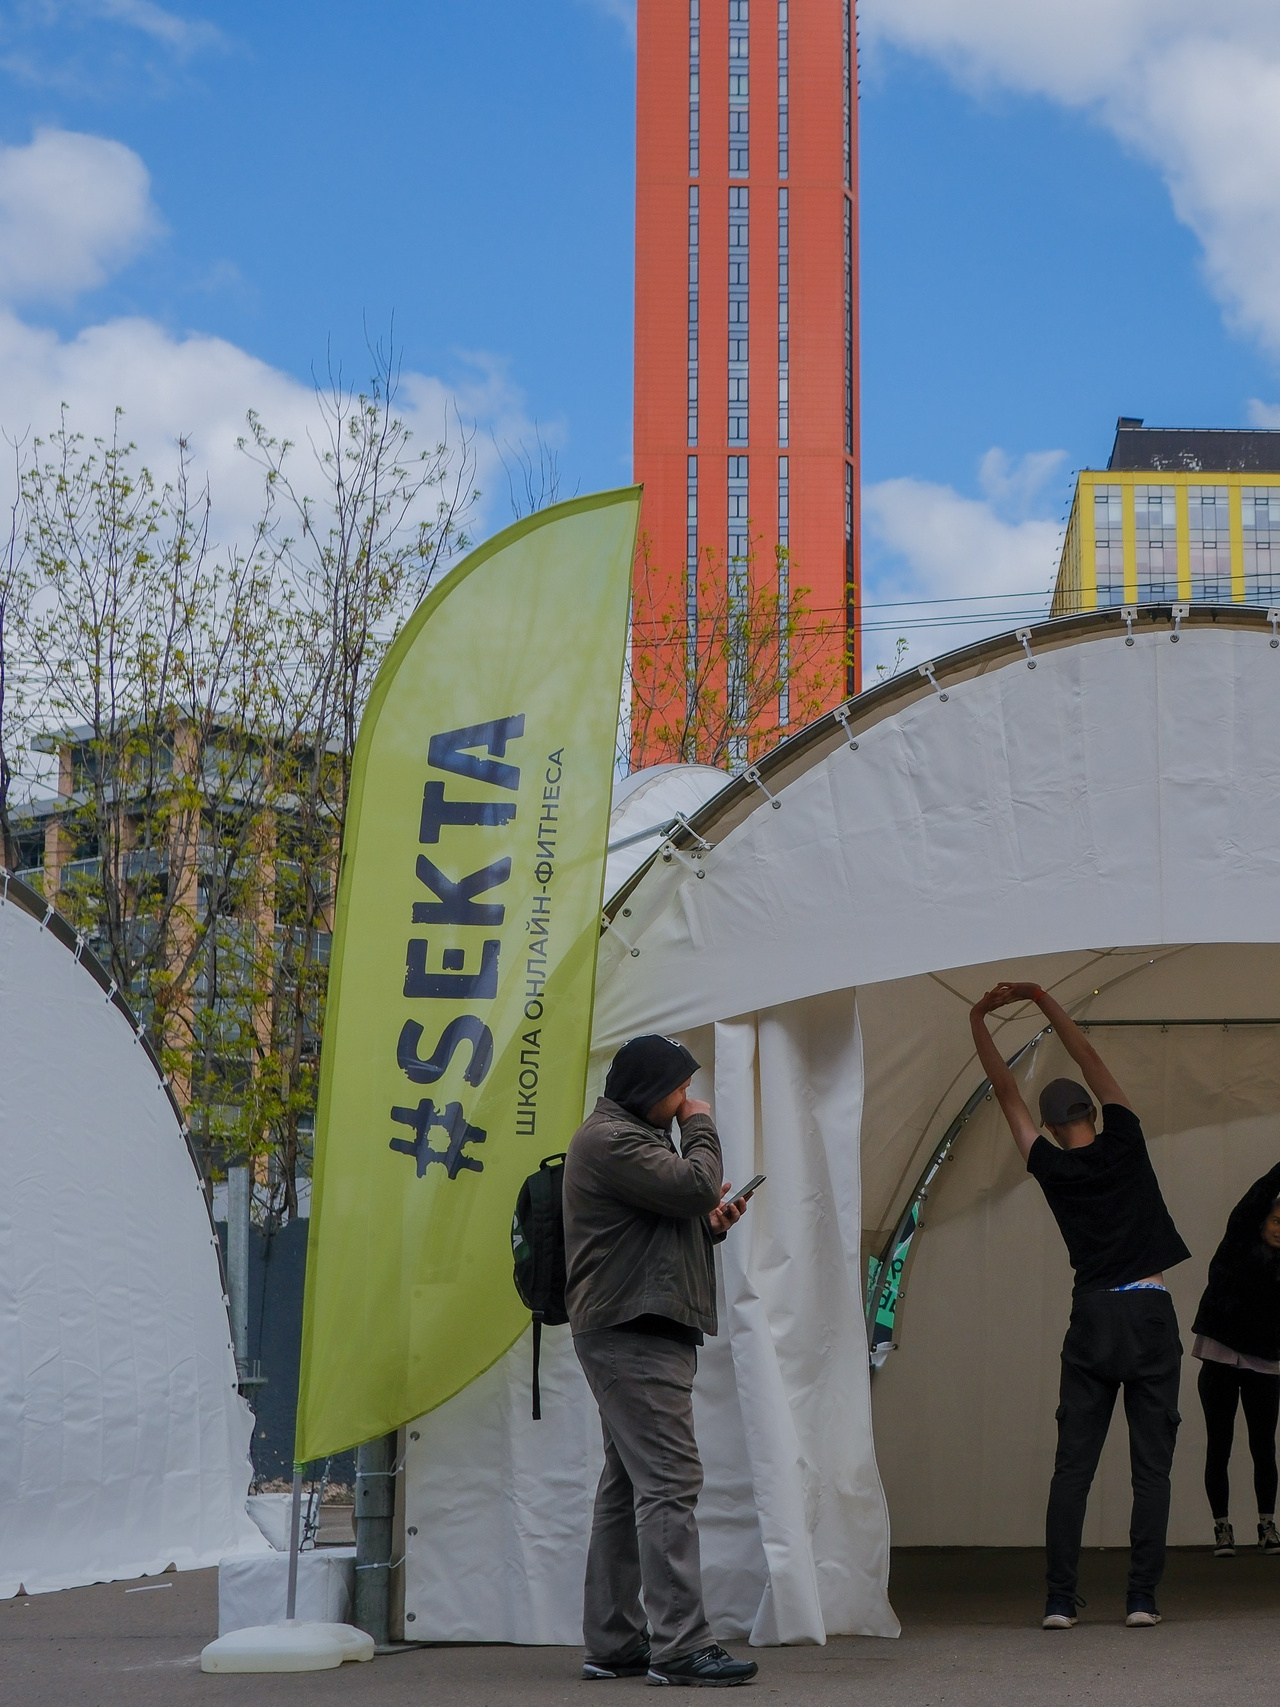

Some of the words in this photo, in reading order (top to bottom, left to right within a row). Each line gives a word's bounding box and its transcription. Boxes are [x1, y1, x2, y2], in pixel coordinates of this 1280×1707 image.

[388, 713, 526, 1181] #SEKTA
[523, 746, 565, 1021] ОНЛАЙН-ФИТНЕСА
[515, 1027, 542, 1137] ШКОЛА
